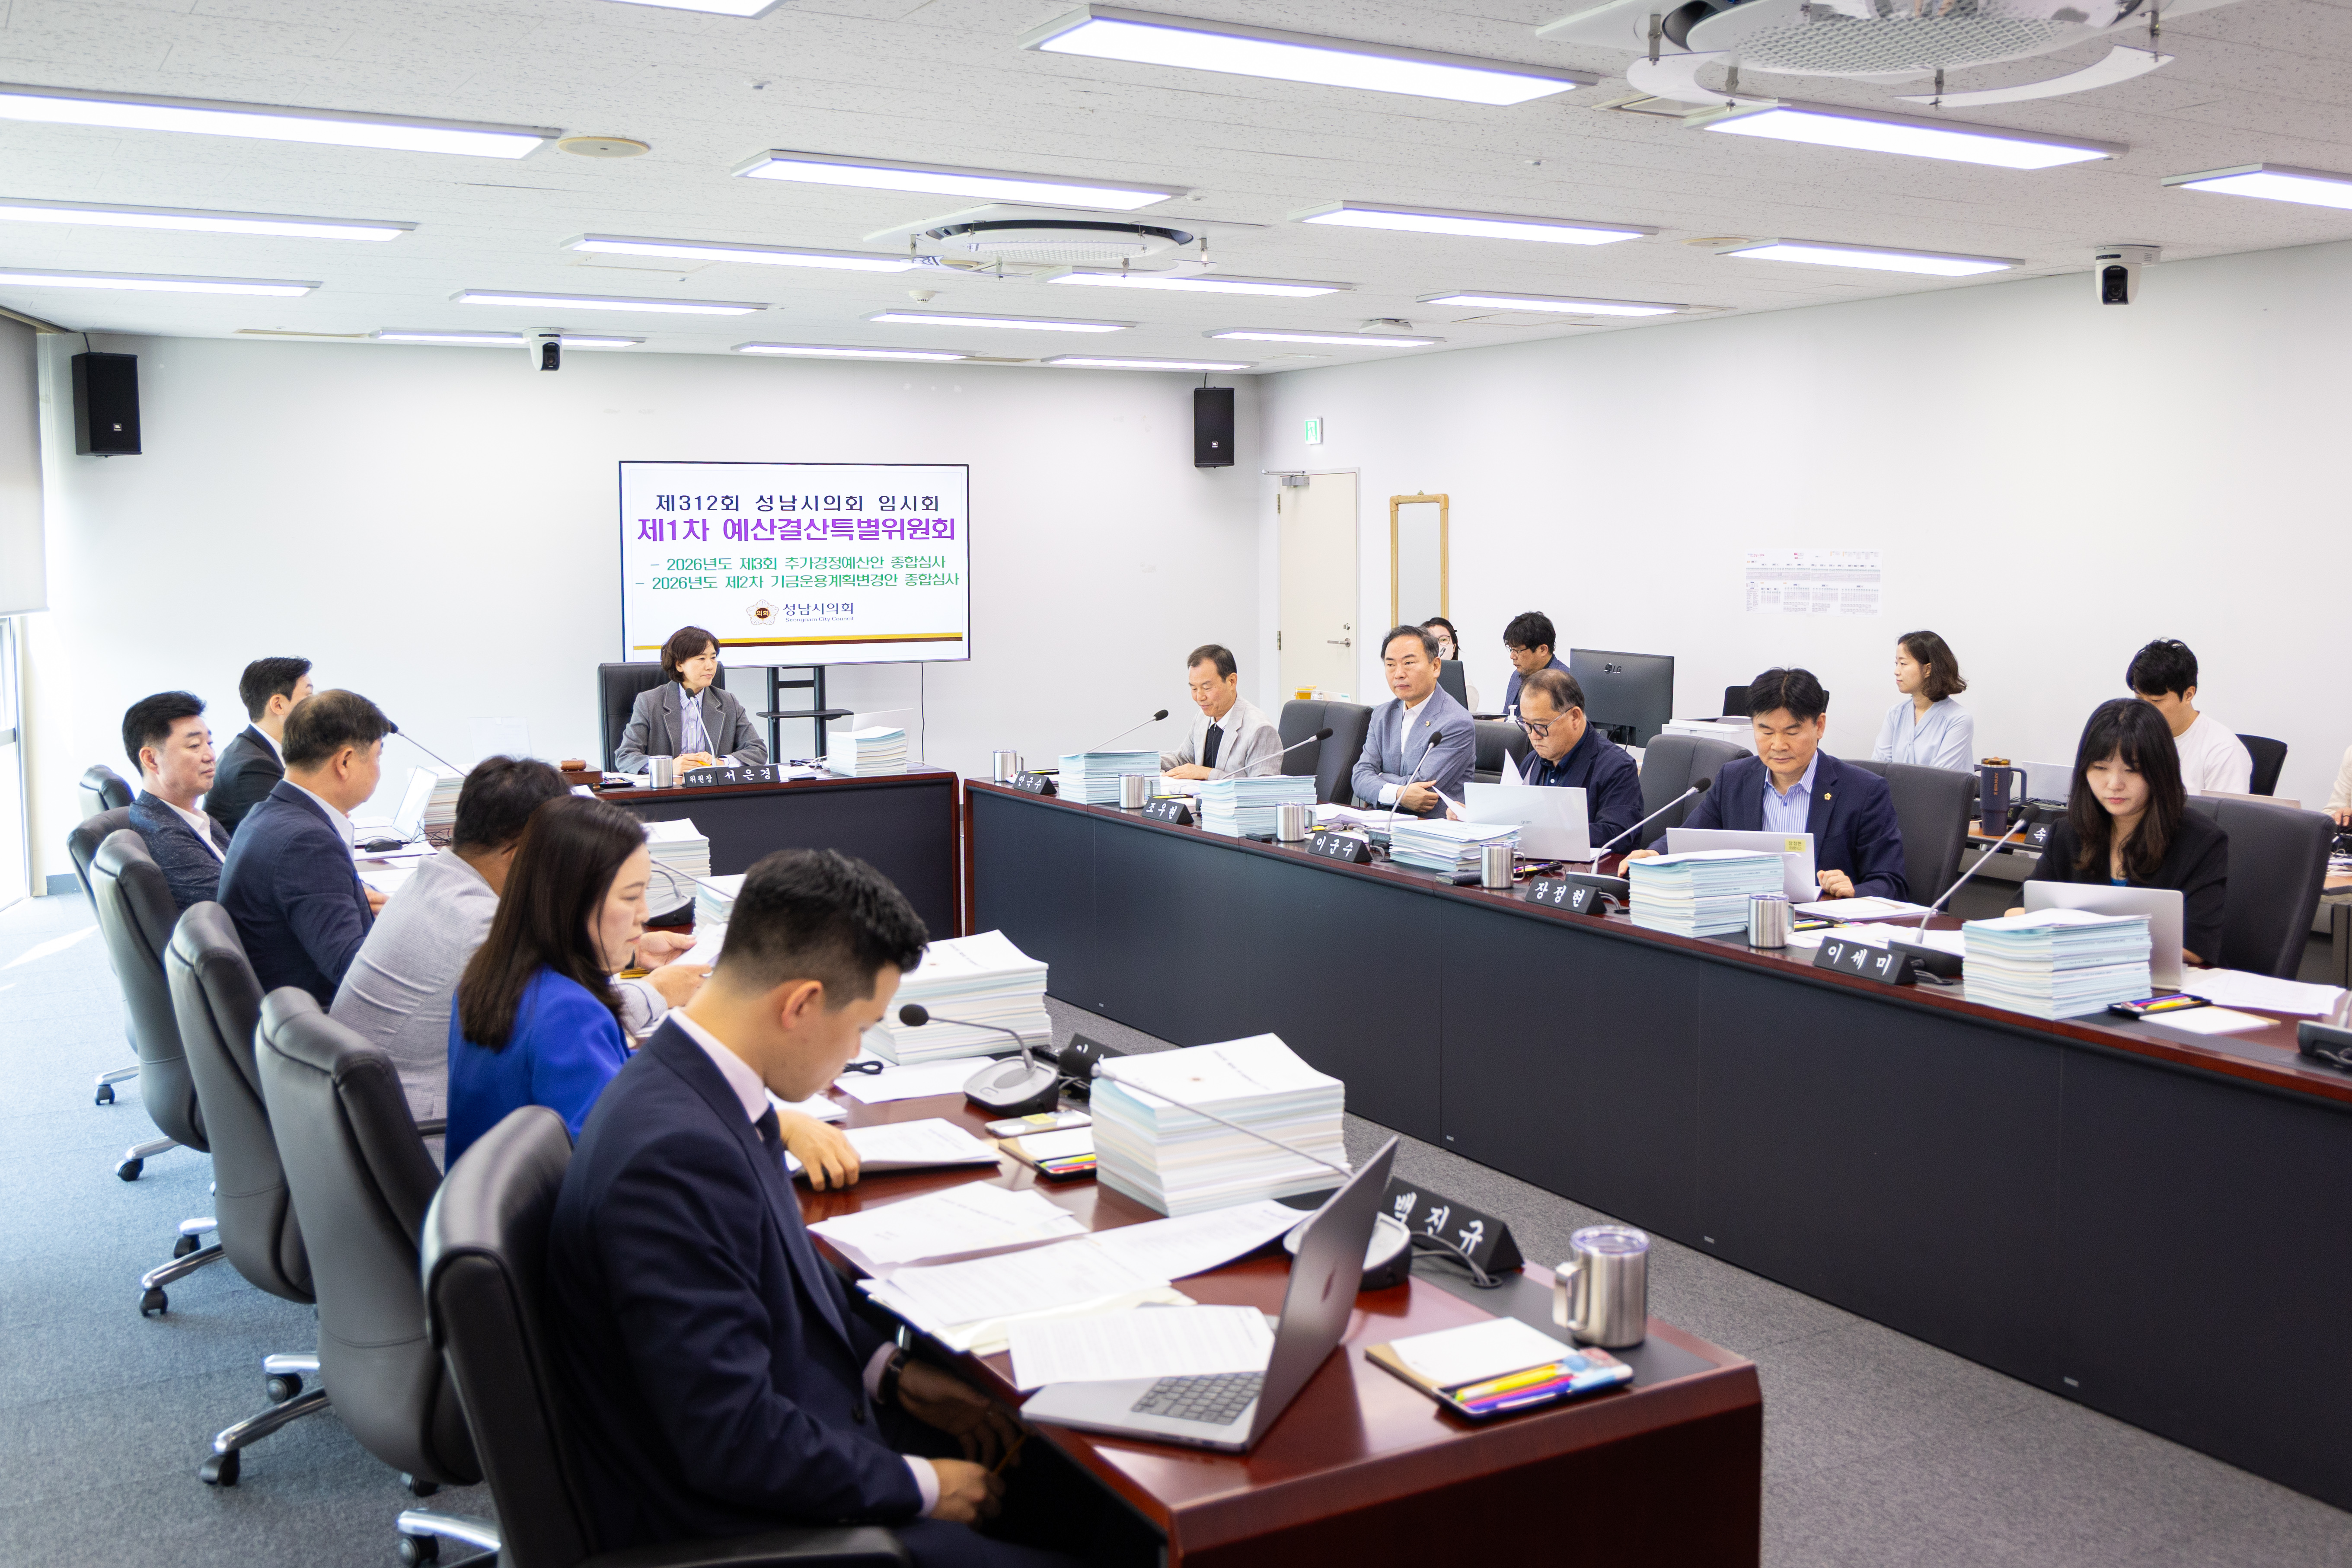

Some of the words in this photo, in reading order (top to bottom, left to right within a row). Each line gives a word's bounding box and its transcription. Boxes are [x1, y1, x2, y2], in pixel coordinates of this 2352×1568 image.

[656, 495, 739, 511] 제312회
[755, 495, 862, 512] 성남시의회
[879, 495, 938, 512] 임시회
[637, 518, 709, 542] 제1차
[723, 518, 954, 541] 예산결산특별위원회
[667, 558, 732, 571] 2026년도
[740, 557, 777, 570] 제3회
[785, 556, 884, 570] 추가경정예산안
[891, 556, 946, 569] 종합심사
[652, 576, 718, 589] 2026년도
[725, 575, 764, 589] 제2차
[771, 574, 898, 588] 기금운용계획변경안
[904, 573, 959, 586] 종합심사
[783, 603, 853, 616] 성남시의회
[1612, 665, 1622, 674] LG
[689, 774, 713, 783] 위원장
[725, 767, 771, 782] 서은경
[1146, 802, 1178, 820] 조우현
[1316, 835, 1354, 857] 이군수
[1534, 881, 1586, 907] 장정현
[1827, 942, 1893, 976] 이세미
